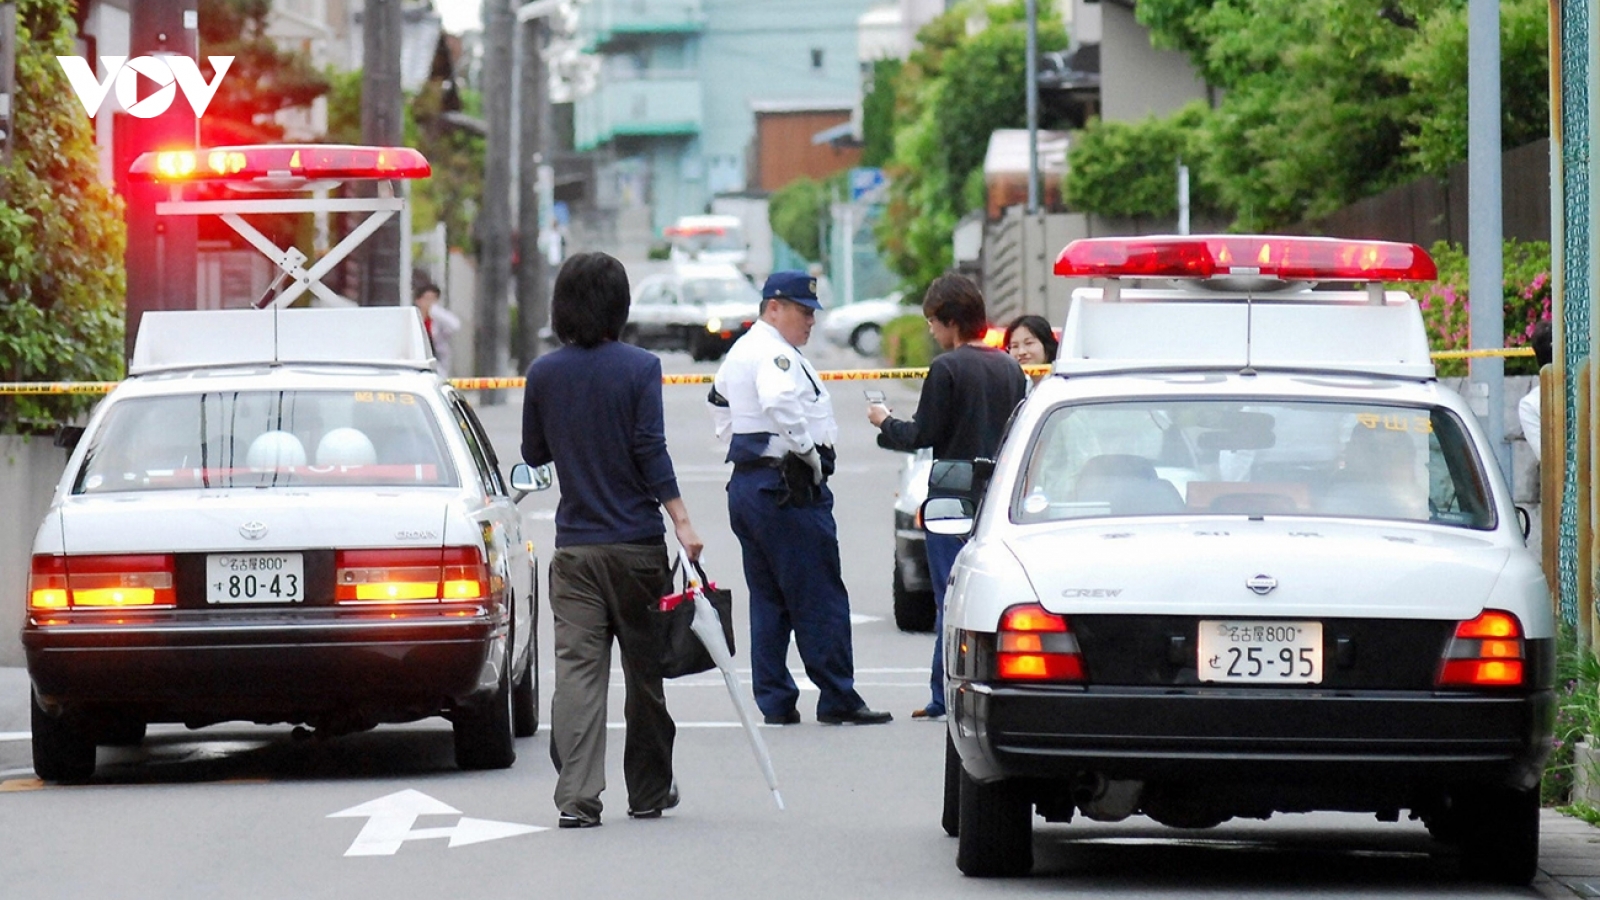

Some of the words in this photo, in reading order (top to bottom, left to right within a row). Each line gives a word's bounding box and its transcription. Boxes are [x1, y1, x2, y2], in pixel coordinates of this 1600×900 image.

[229, 574, 298, 598] 80-43
[1061, 588, 1123, 598] CREW
[1226, 647, 1314, 677] 25-95
